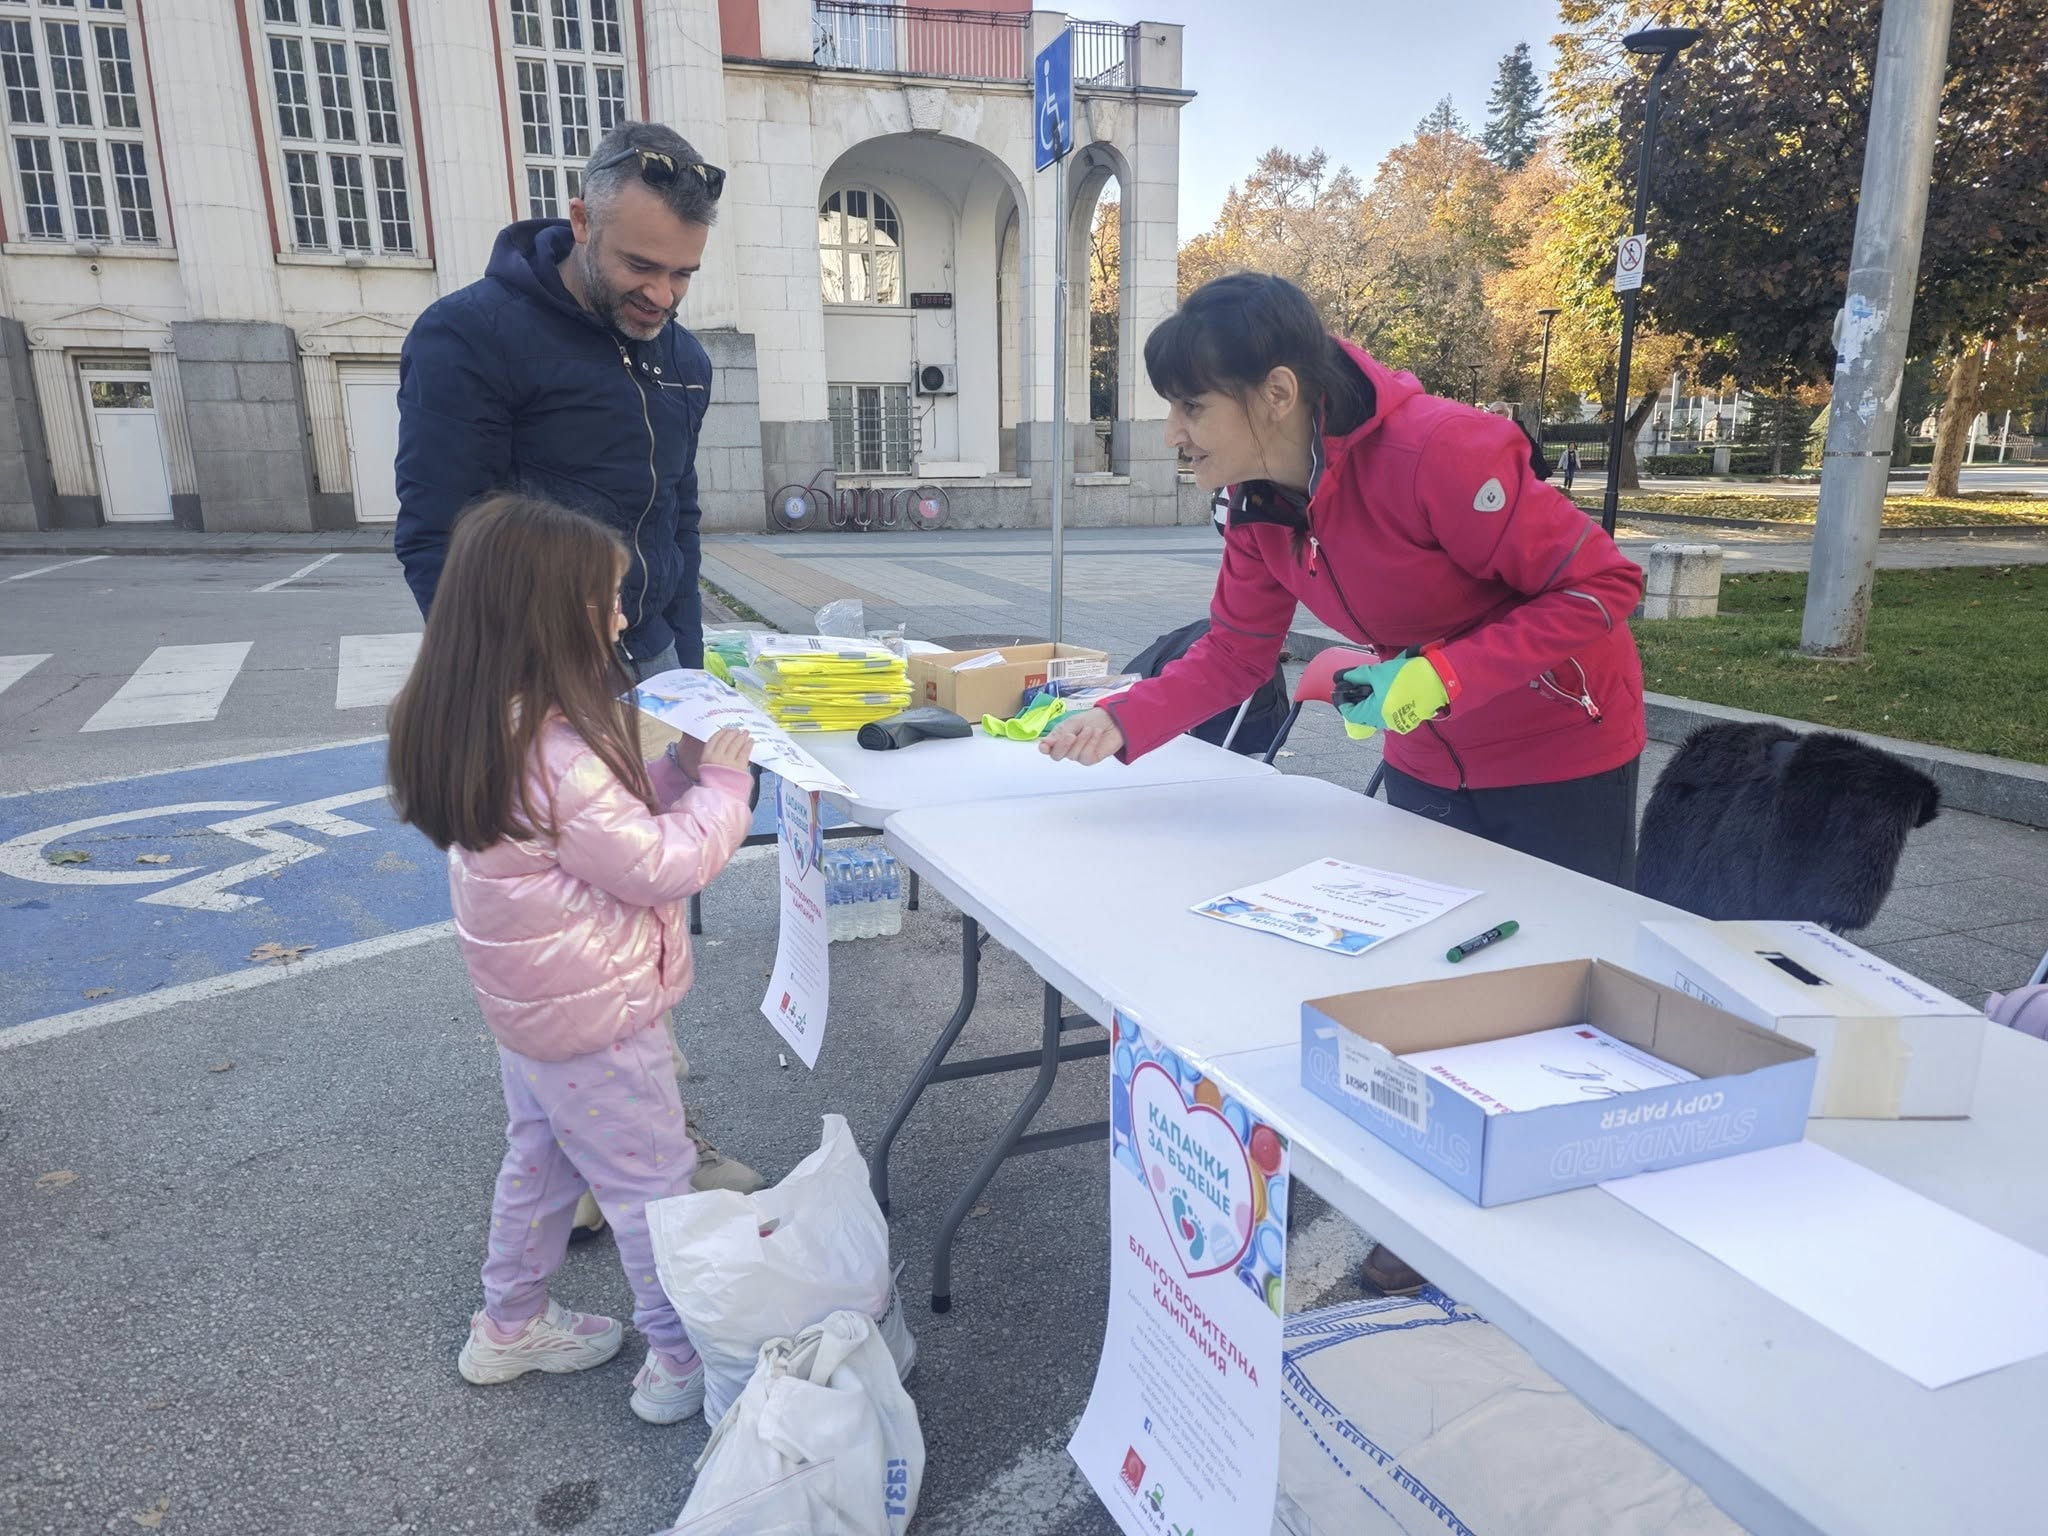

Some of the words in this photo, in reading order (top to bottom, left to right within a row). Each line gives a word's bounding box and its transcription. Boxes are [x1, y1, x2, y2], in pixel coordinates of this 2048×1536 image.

[1148, 1101, 1230, 1189] КАПАЧКИ
[1551, 1108, 1758, 1180] STANDARD
[1601, 1101, 1668, 1129] PAPER
[1671, 1091, 1724, 1117] COPY
[1147, 1128, 1164, 1160] ЗА
[1167, 1149, 1231, 1217] БЪДЕЩЕ
[1129, 1234, 1259, 1388] БЛАГОТВОРИТЕЛНА
[1153, 1281, 1227, 1377] КАМПАНИЯ
